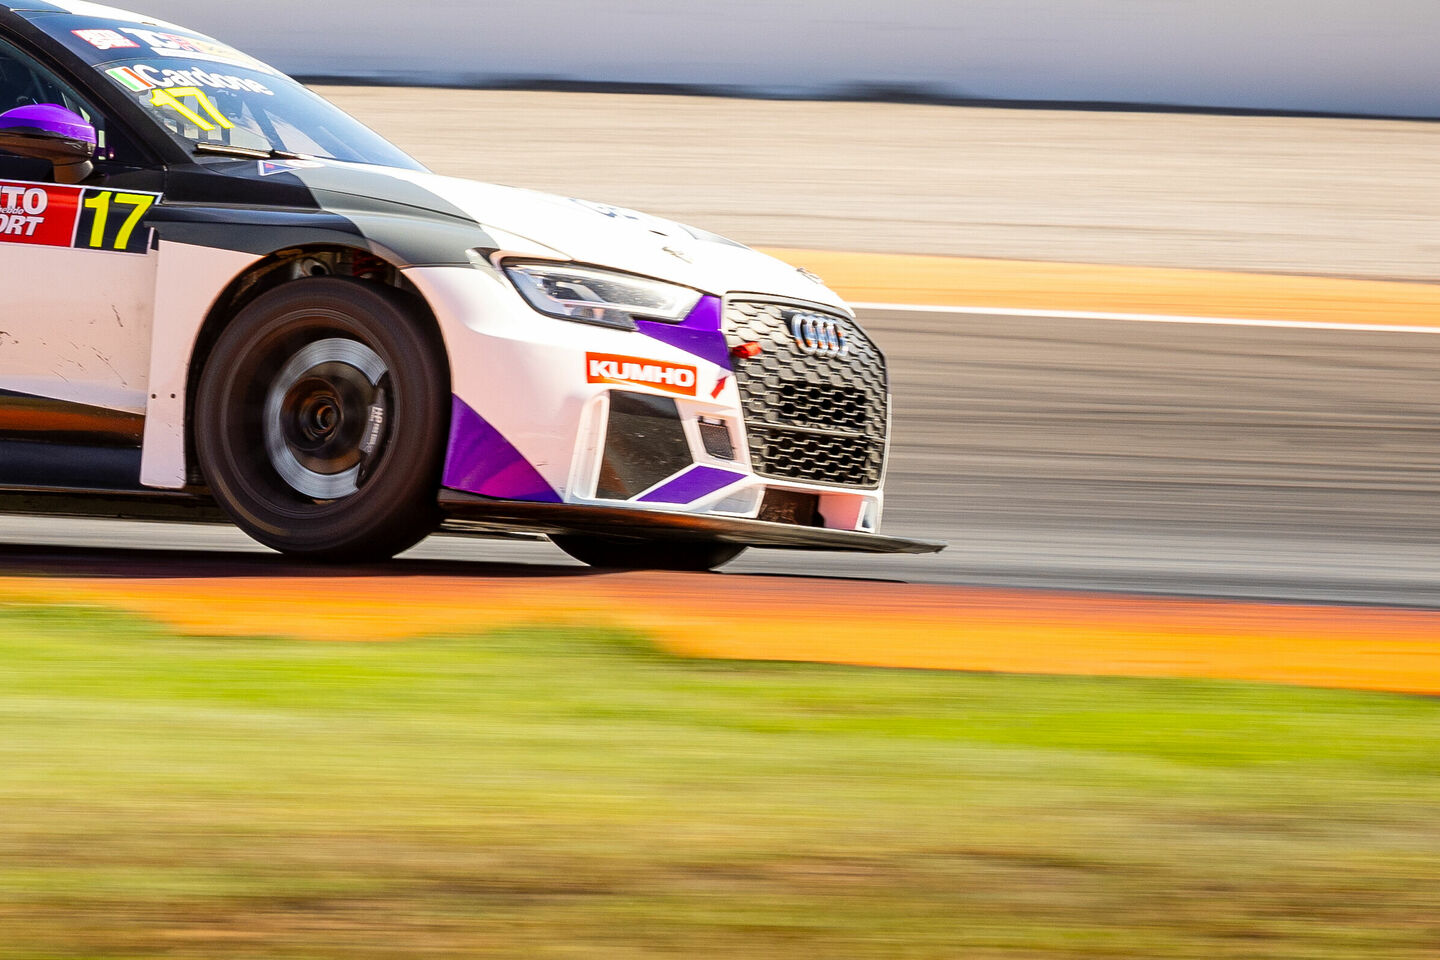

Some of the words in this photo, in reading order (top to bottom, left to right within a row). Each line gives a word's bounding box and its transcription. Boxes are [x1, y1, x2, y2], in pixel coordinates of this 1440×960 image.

[133, 64, 275, 96] Cardone
[149, 86, 235, 131] 17
[84, 190, 155, 250] 17
[589, 359, 695, 388] KUMHO
